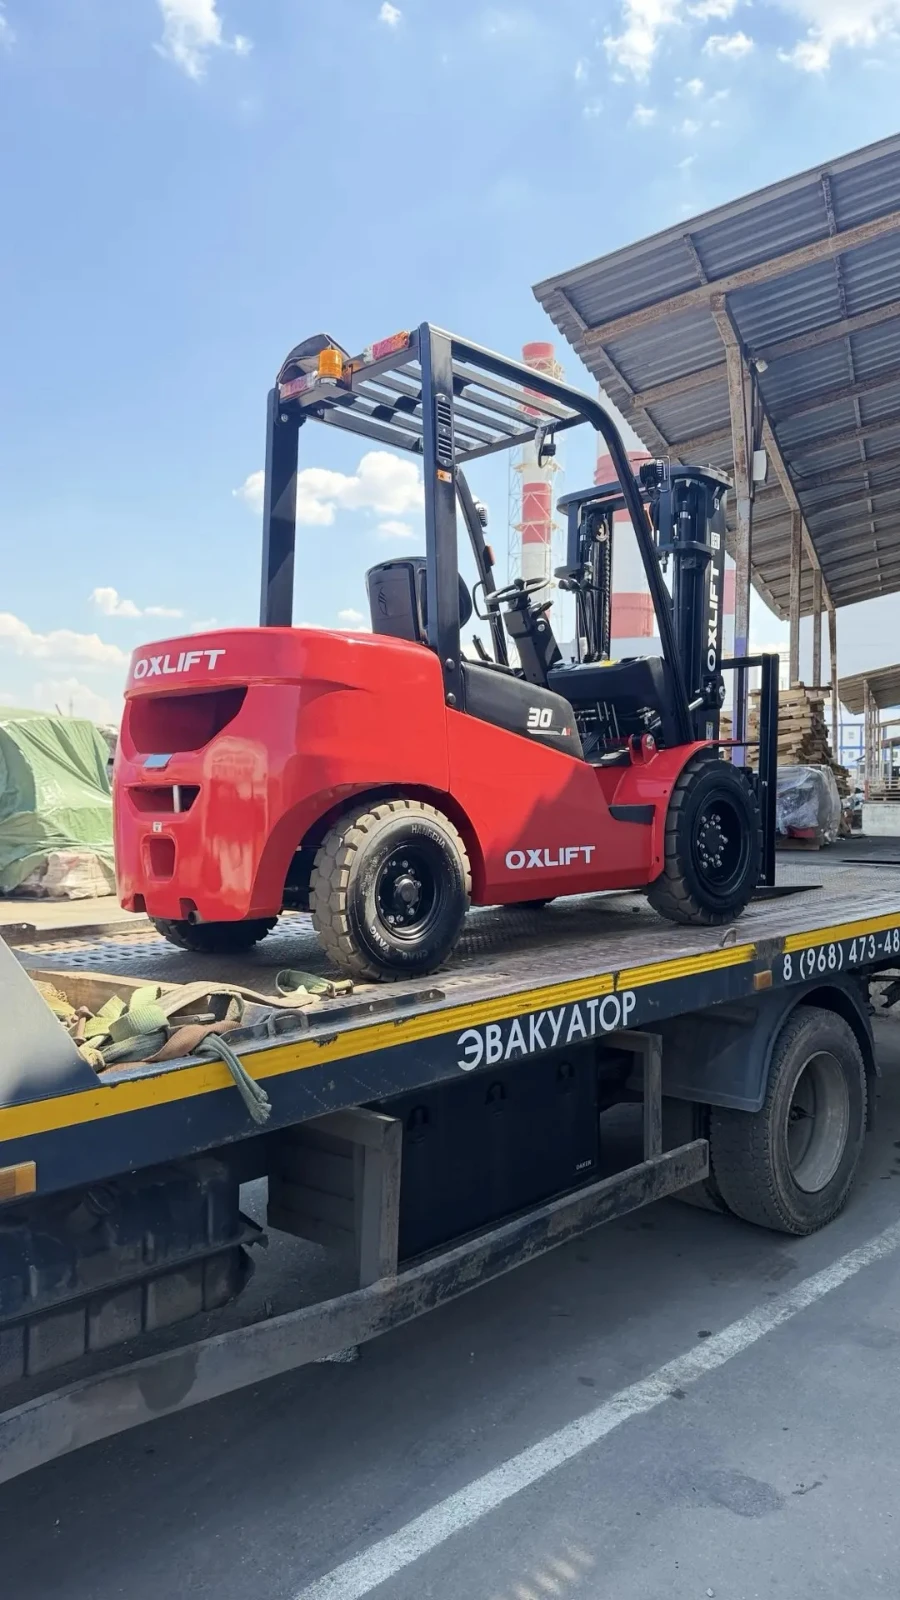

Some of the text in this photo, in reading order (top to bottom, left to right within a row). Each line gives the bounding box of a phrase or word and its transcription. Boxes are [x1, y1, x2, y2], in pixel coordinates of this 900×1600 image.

[707, 560, 720, 672] OXLIFT
[133, 649, 226, 679] OXLIFT
[526, 706, 553, 727] 30
[505, 845, 596, 870] OXLIFT
[783, 928, 900, 981] 8 (968) 473-48
[457, 990, 637, 1072] ЭВАКУАТОР
